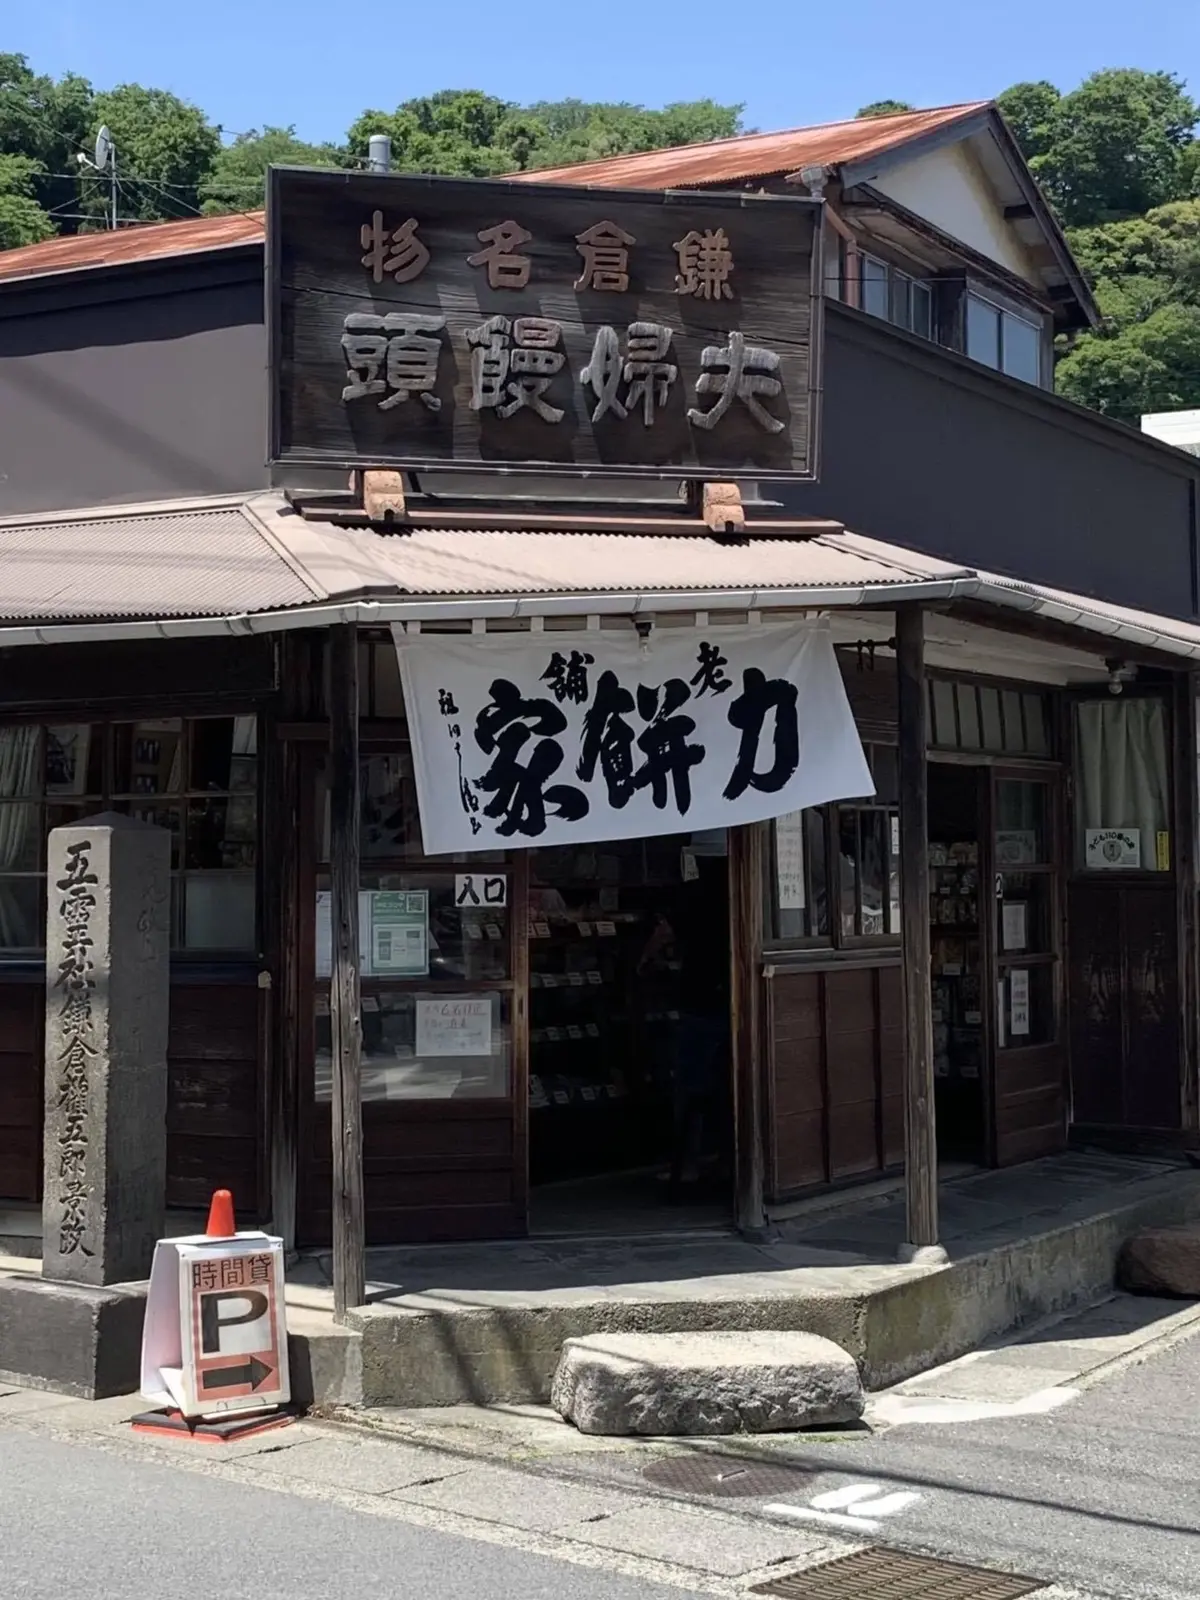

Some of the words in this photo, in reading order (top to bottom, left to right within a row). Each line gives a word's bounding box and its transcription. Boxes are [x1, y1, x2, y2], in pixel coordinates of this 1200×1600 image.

[341, 312, 786, 434] 夫婦饅頭
[473, 667, 799, 837] 力餅家
[457, 876, 505, 904] 入口
[192, 1254, 272, 1289] 時間貸
[200, 1290, 268, 1354] P
